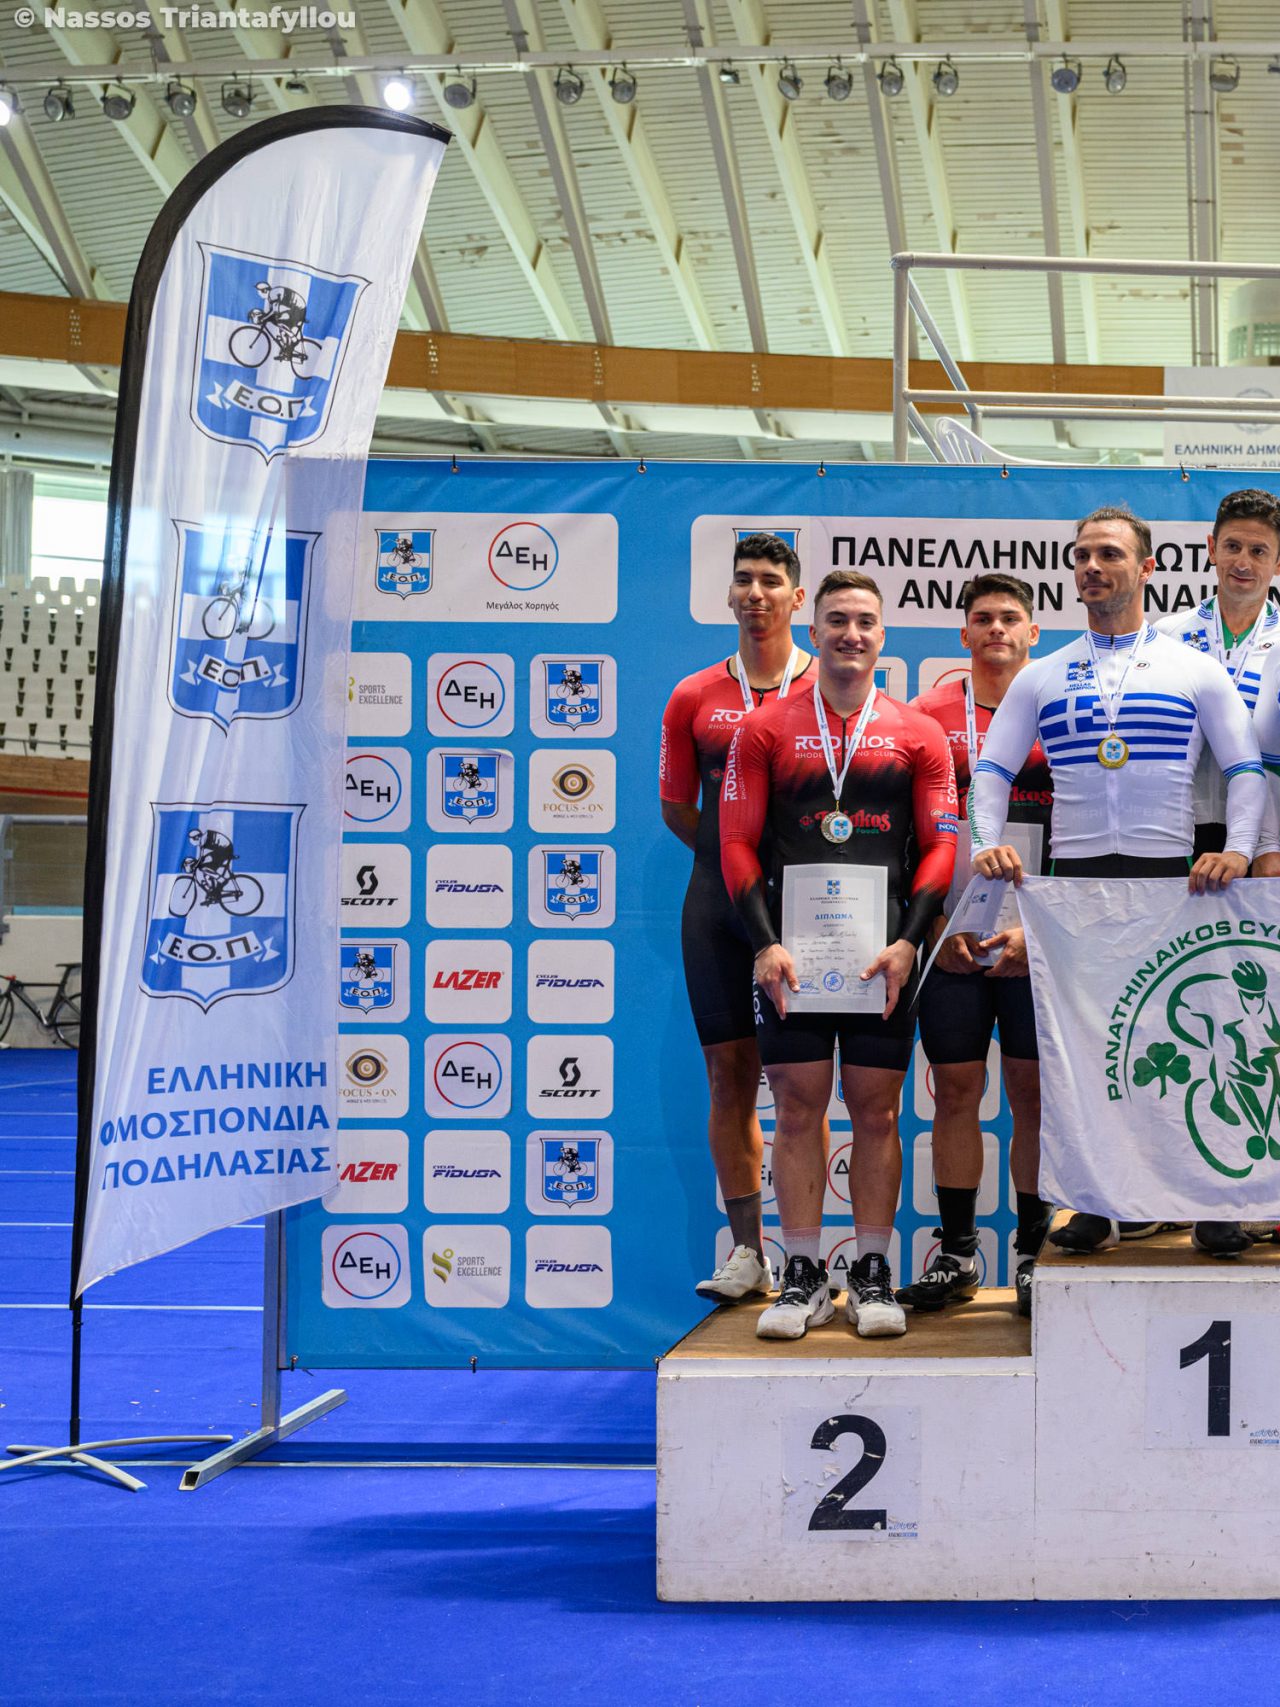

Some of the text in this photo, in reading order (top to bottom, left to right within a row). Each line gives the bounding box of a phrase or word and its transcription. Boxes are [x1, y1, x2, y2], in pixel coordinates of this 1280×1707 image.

[1175, 445, 1242, 455] ΕΛΛΗΝΙΚΗ
[486, 601, 559, 611] Μεγάλος Χορηγός
[359, 685, 386, 694] SPORTS
[359, 695, 403, 705] EXCELLENCE
[543, 803, 579, 812] FOCUS
[341, 898, 398, 906] SCOTT
[433, 969, 501, 990] LAZER
[1108, 920, 1231, 1101] PANATHINAIKOS
[148, 1061, 327, 1094] ΕΛΛΗΝΙΚΗ
[100, 1104, 329, 1146] ΟΜΟΣΠΟΝΔΙΑ
[102, 1146, 331, 1190] ΠΟΔΗΛΑΣΙΑΣ
[337, 1162, 398, 1182] AZER
[457, 1257, 484, 1265] SPORTS
[457, 1267, 502, 1276] EXCELLENCE
[1180, 1320, 1231, 1436] 1
[808, 1414, 887, 1531] 2
